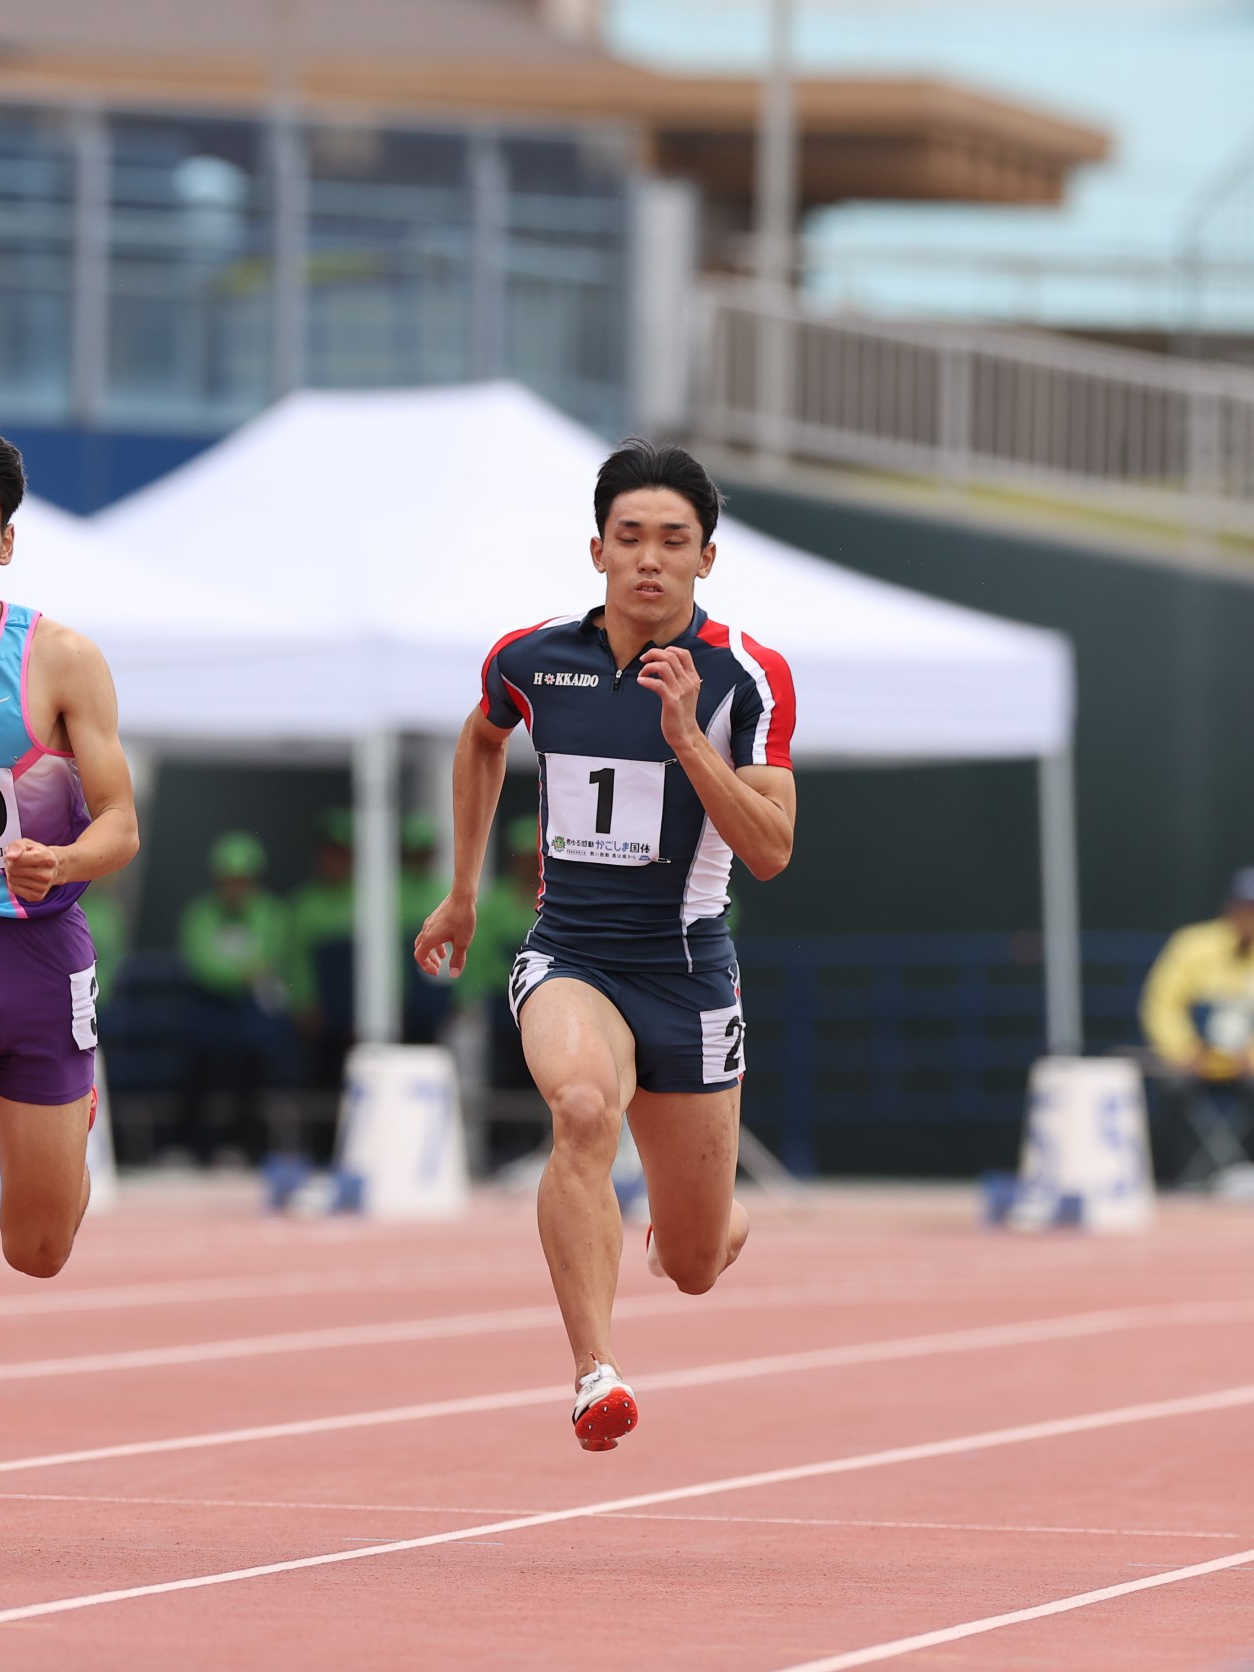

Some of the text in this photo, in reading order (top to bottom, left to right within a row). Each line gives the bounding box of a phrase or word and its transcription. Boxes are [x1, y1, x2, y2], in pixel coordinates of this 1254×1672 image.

[588, 767, 615, 834] 1
[595, 839, 651, 854] かごしま国体
[724, 1015, 743, 1073] 2
